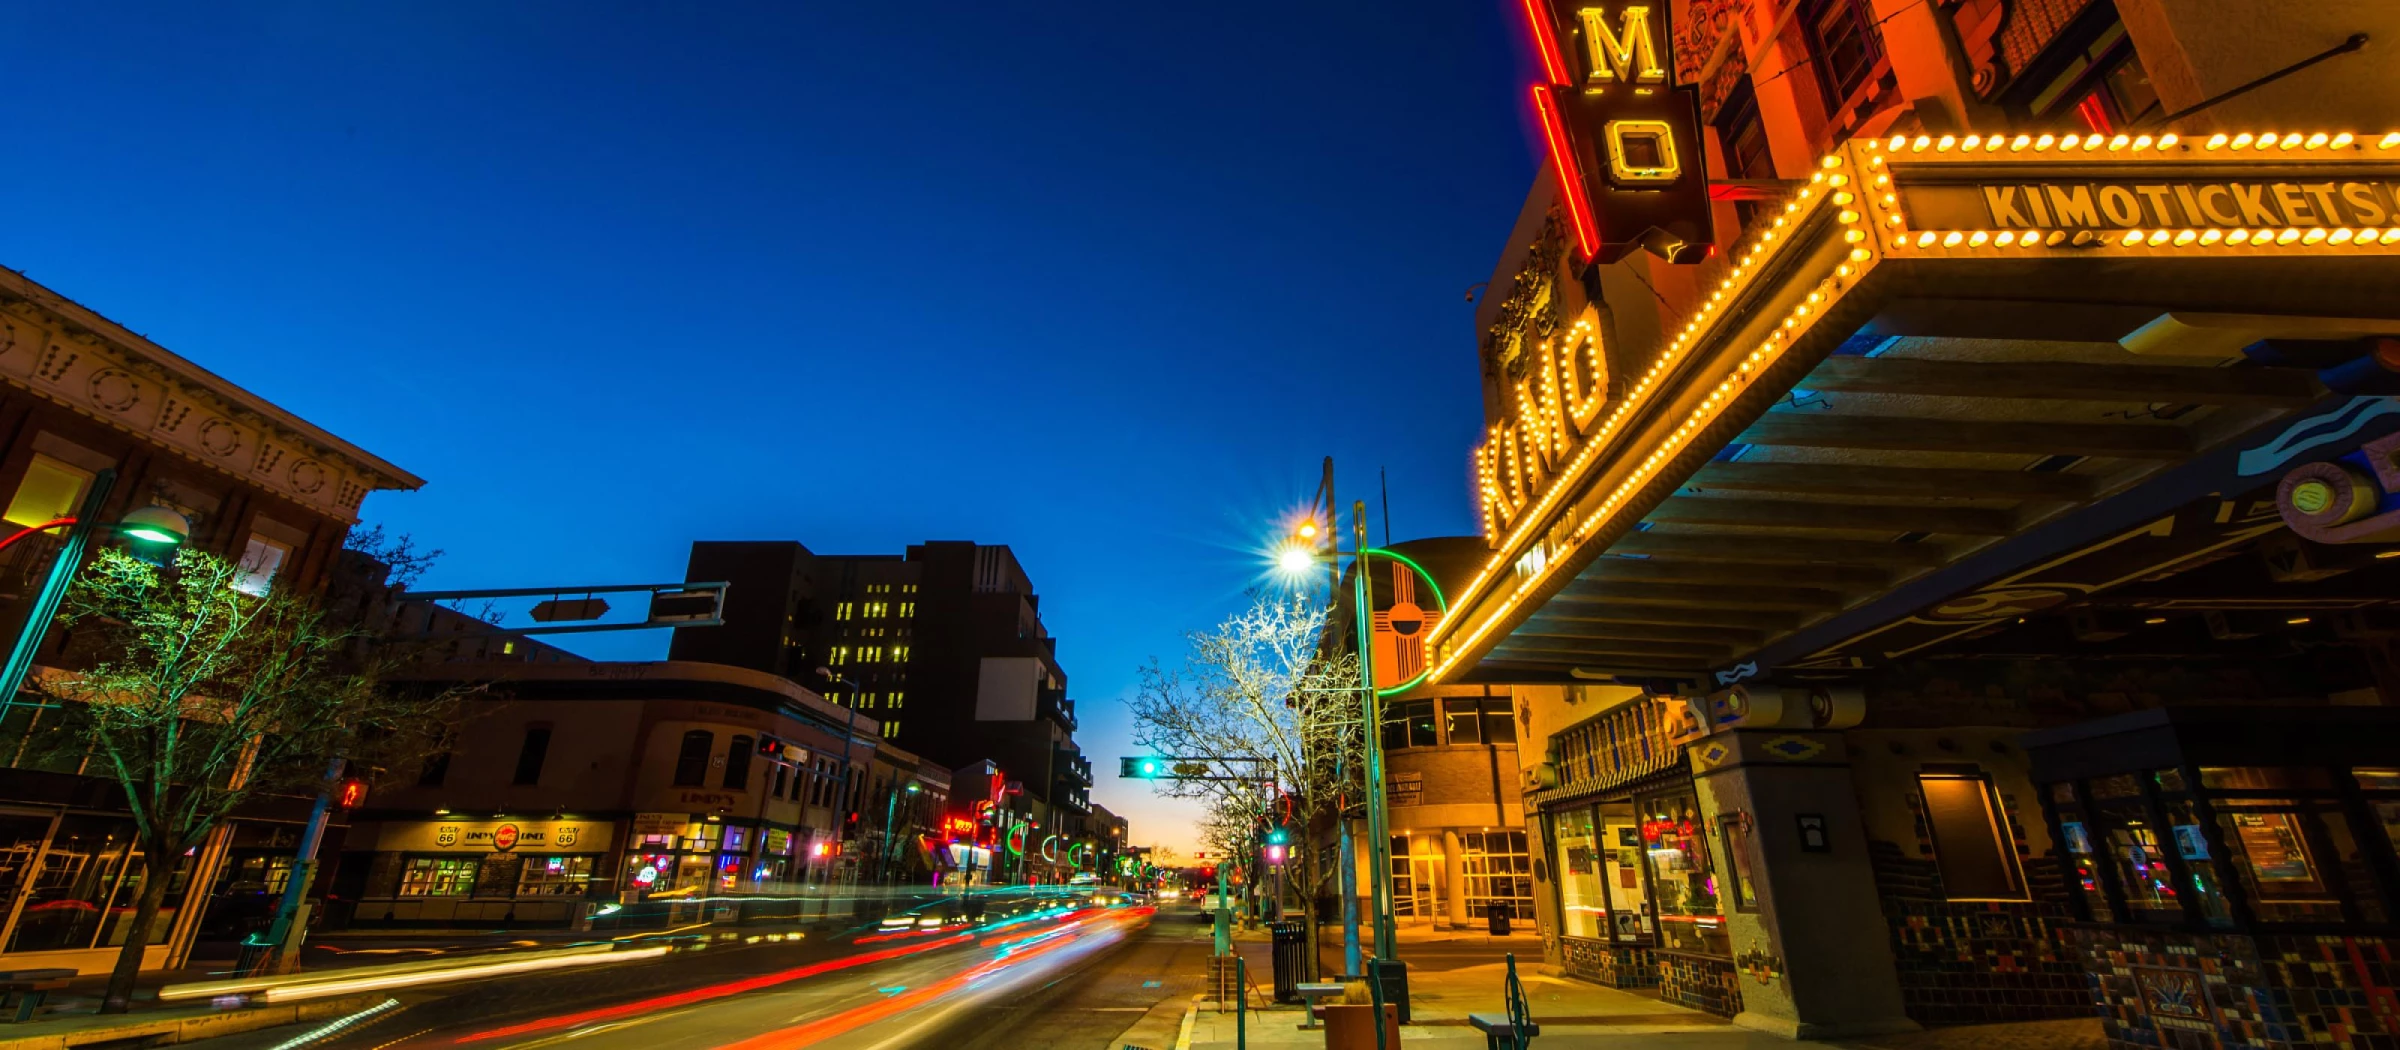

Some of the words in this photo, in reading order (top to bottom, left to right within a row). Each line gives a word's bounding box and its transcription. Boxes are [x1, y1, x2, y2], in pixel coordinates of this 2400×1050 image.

[1984, 183, 2400, 228] KIMOTICKETS.
[1476, 303, 1610, 550] KIMO
[439, 833, 454, 842] 66
[558, 834, 573, 843] 66
